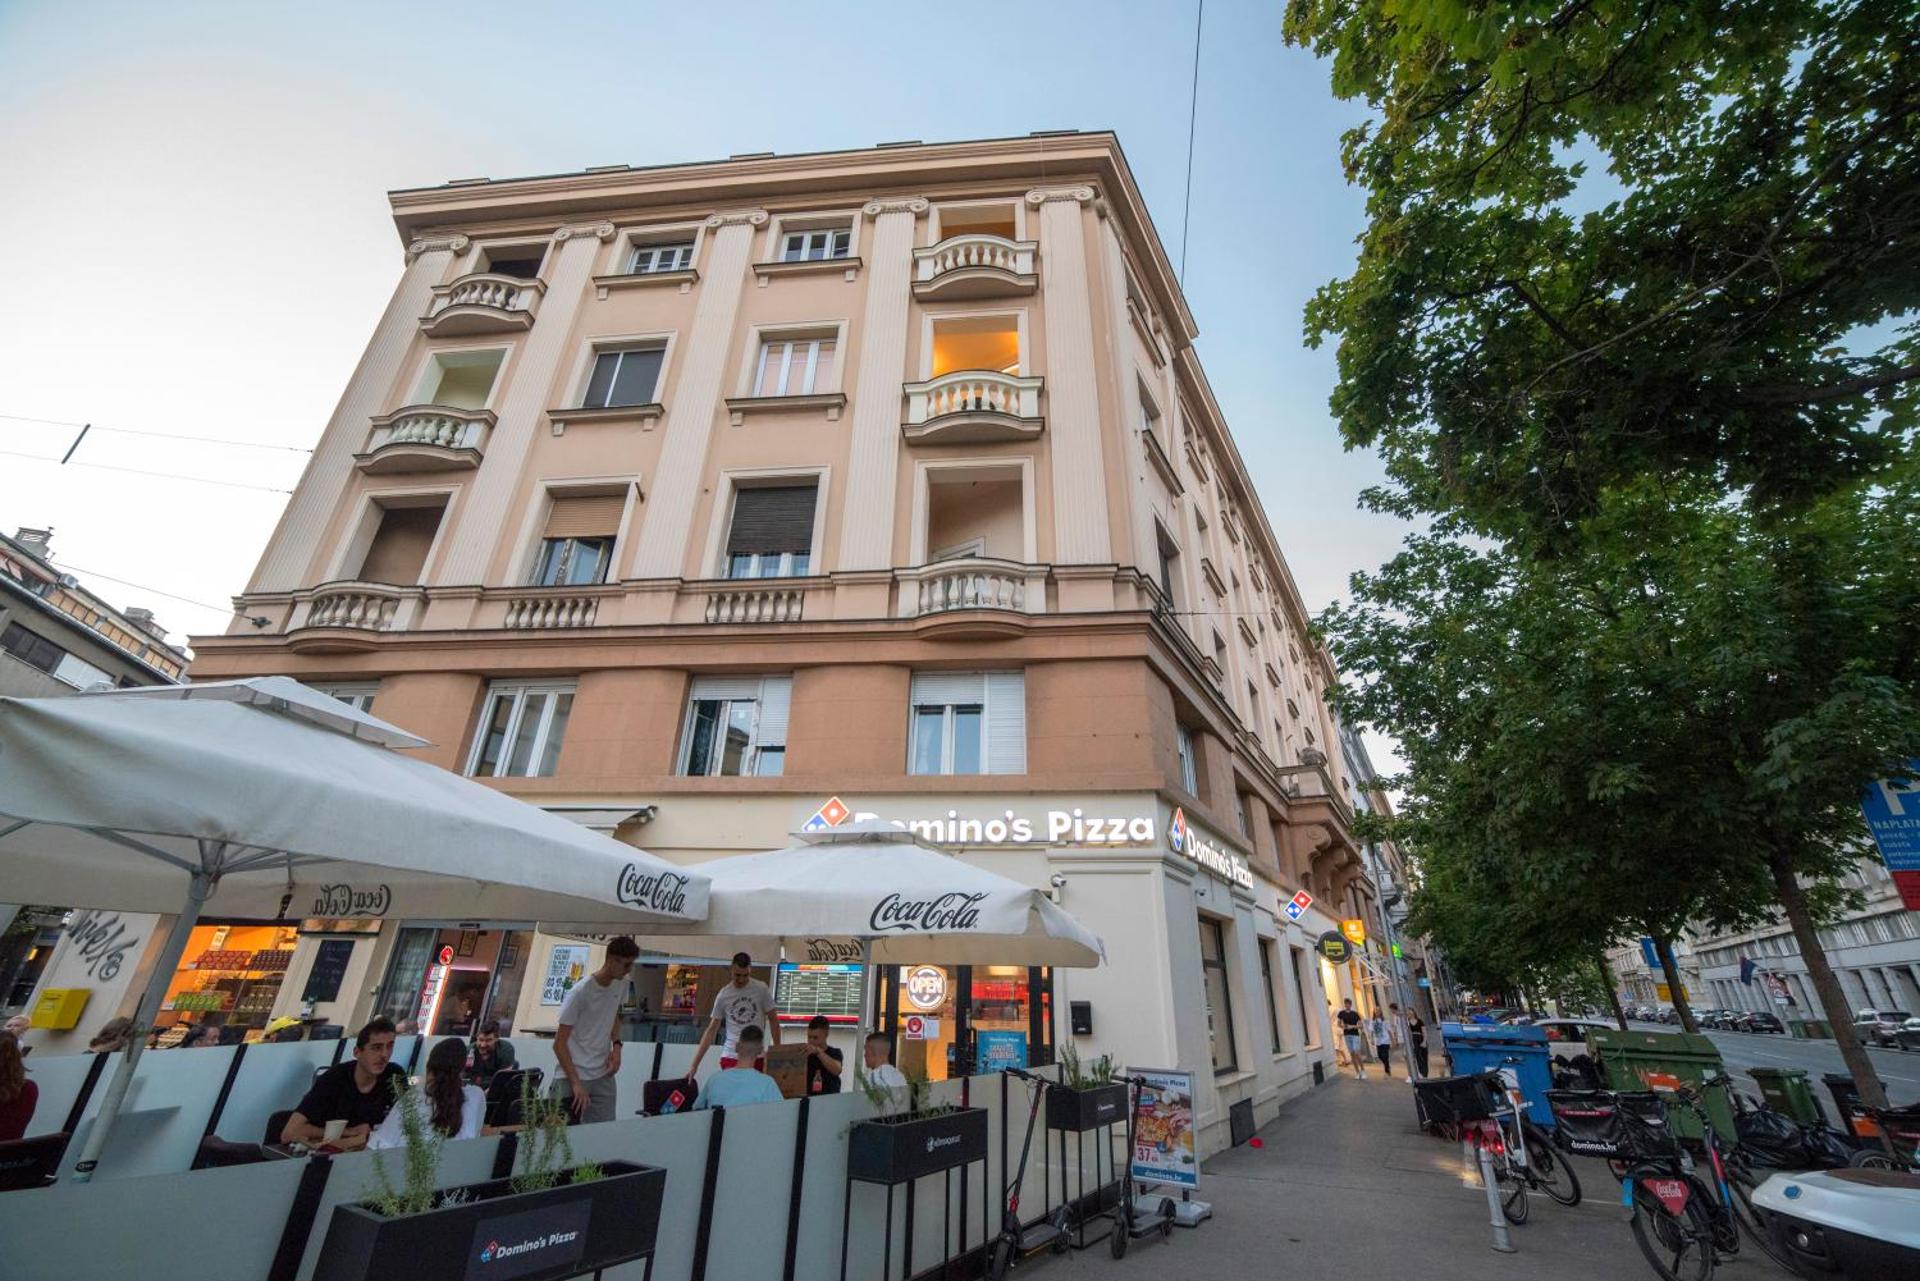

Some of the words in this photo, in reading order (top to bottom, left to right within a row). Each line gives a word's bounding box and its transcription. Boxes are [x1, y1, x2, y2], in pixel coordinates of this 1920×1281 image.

[1048, 808, 1155, 842] Pizza
[1186, 827, 1232, 878] Domino's
[1231, 855, 1253, 889] Pizza
[909, 976, 942, 994] OPEN
[1138, 1147, 1150, 1161] 37
[496, 1236, 546, 1259] Domino's
[548, 1232, 576, 1246] Pizza
